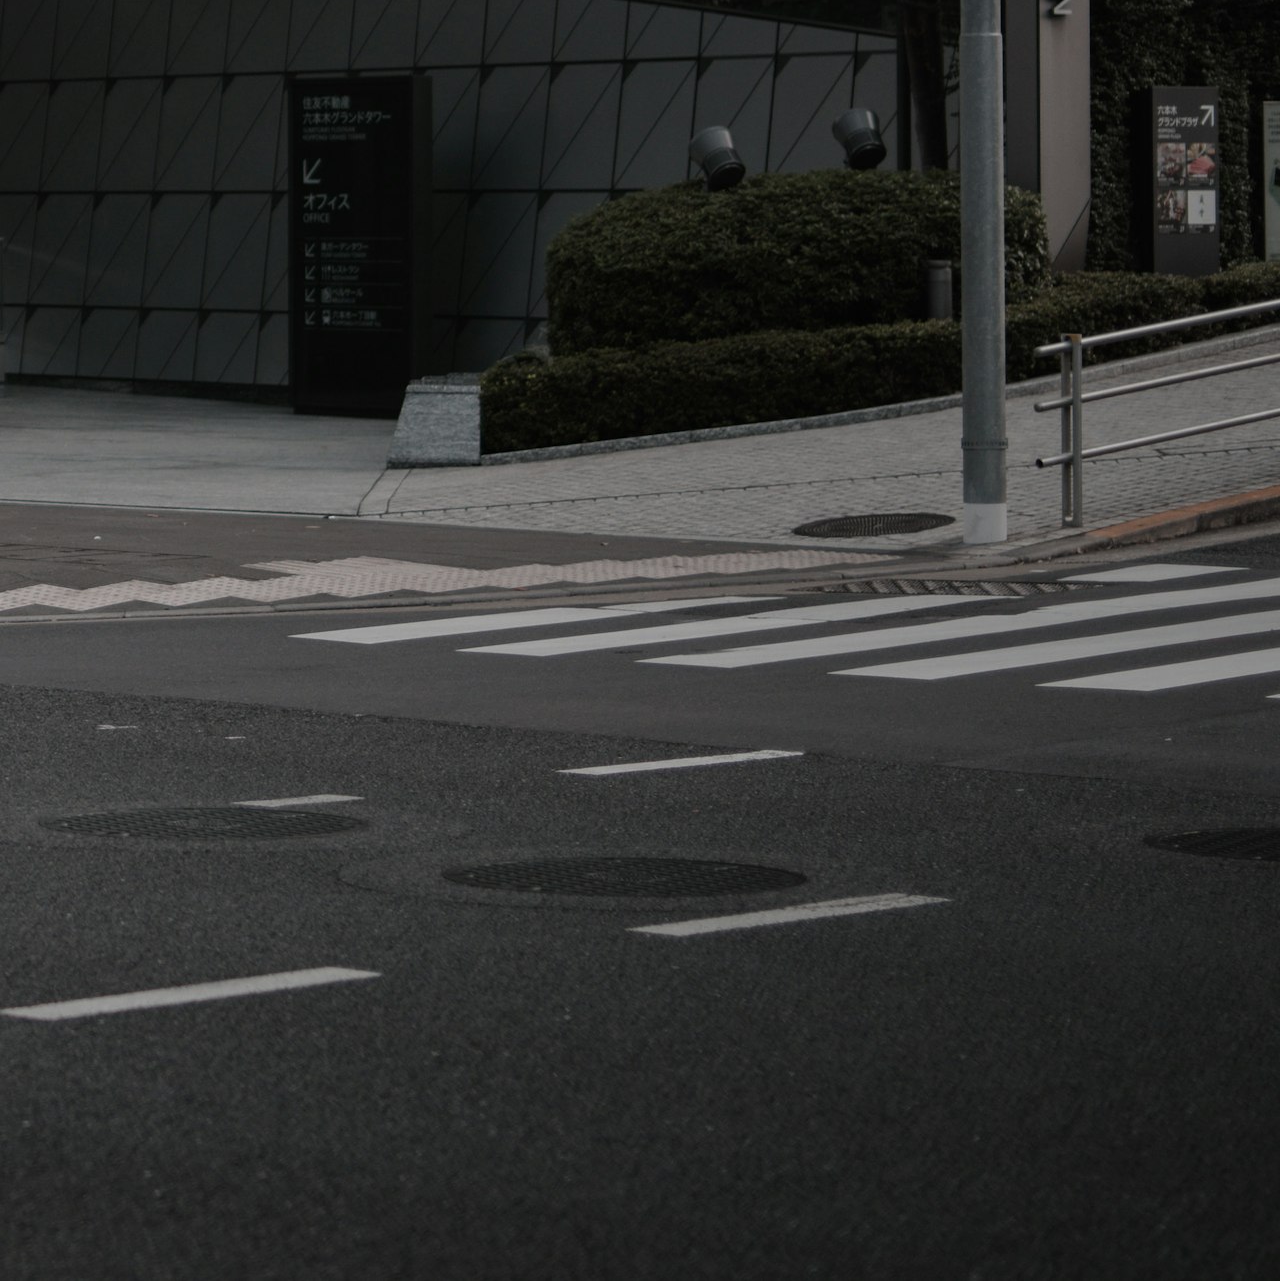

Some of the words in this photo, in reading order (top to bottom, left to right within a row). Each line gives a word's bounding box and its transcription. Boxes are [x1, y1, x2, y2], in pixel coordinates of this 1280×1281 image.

[1157, 105, 1178, 115] 六本木
[302, 110, 392, 125] 六本木グランドタワー
[1157, 116, 1199, 127] グランドプラザ
[303, 192, 351, 210] オフィス
[302, 212, 331, 223] OFFICE
